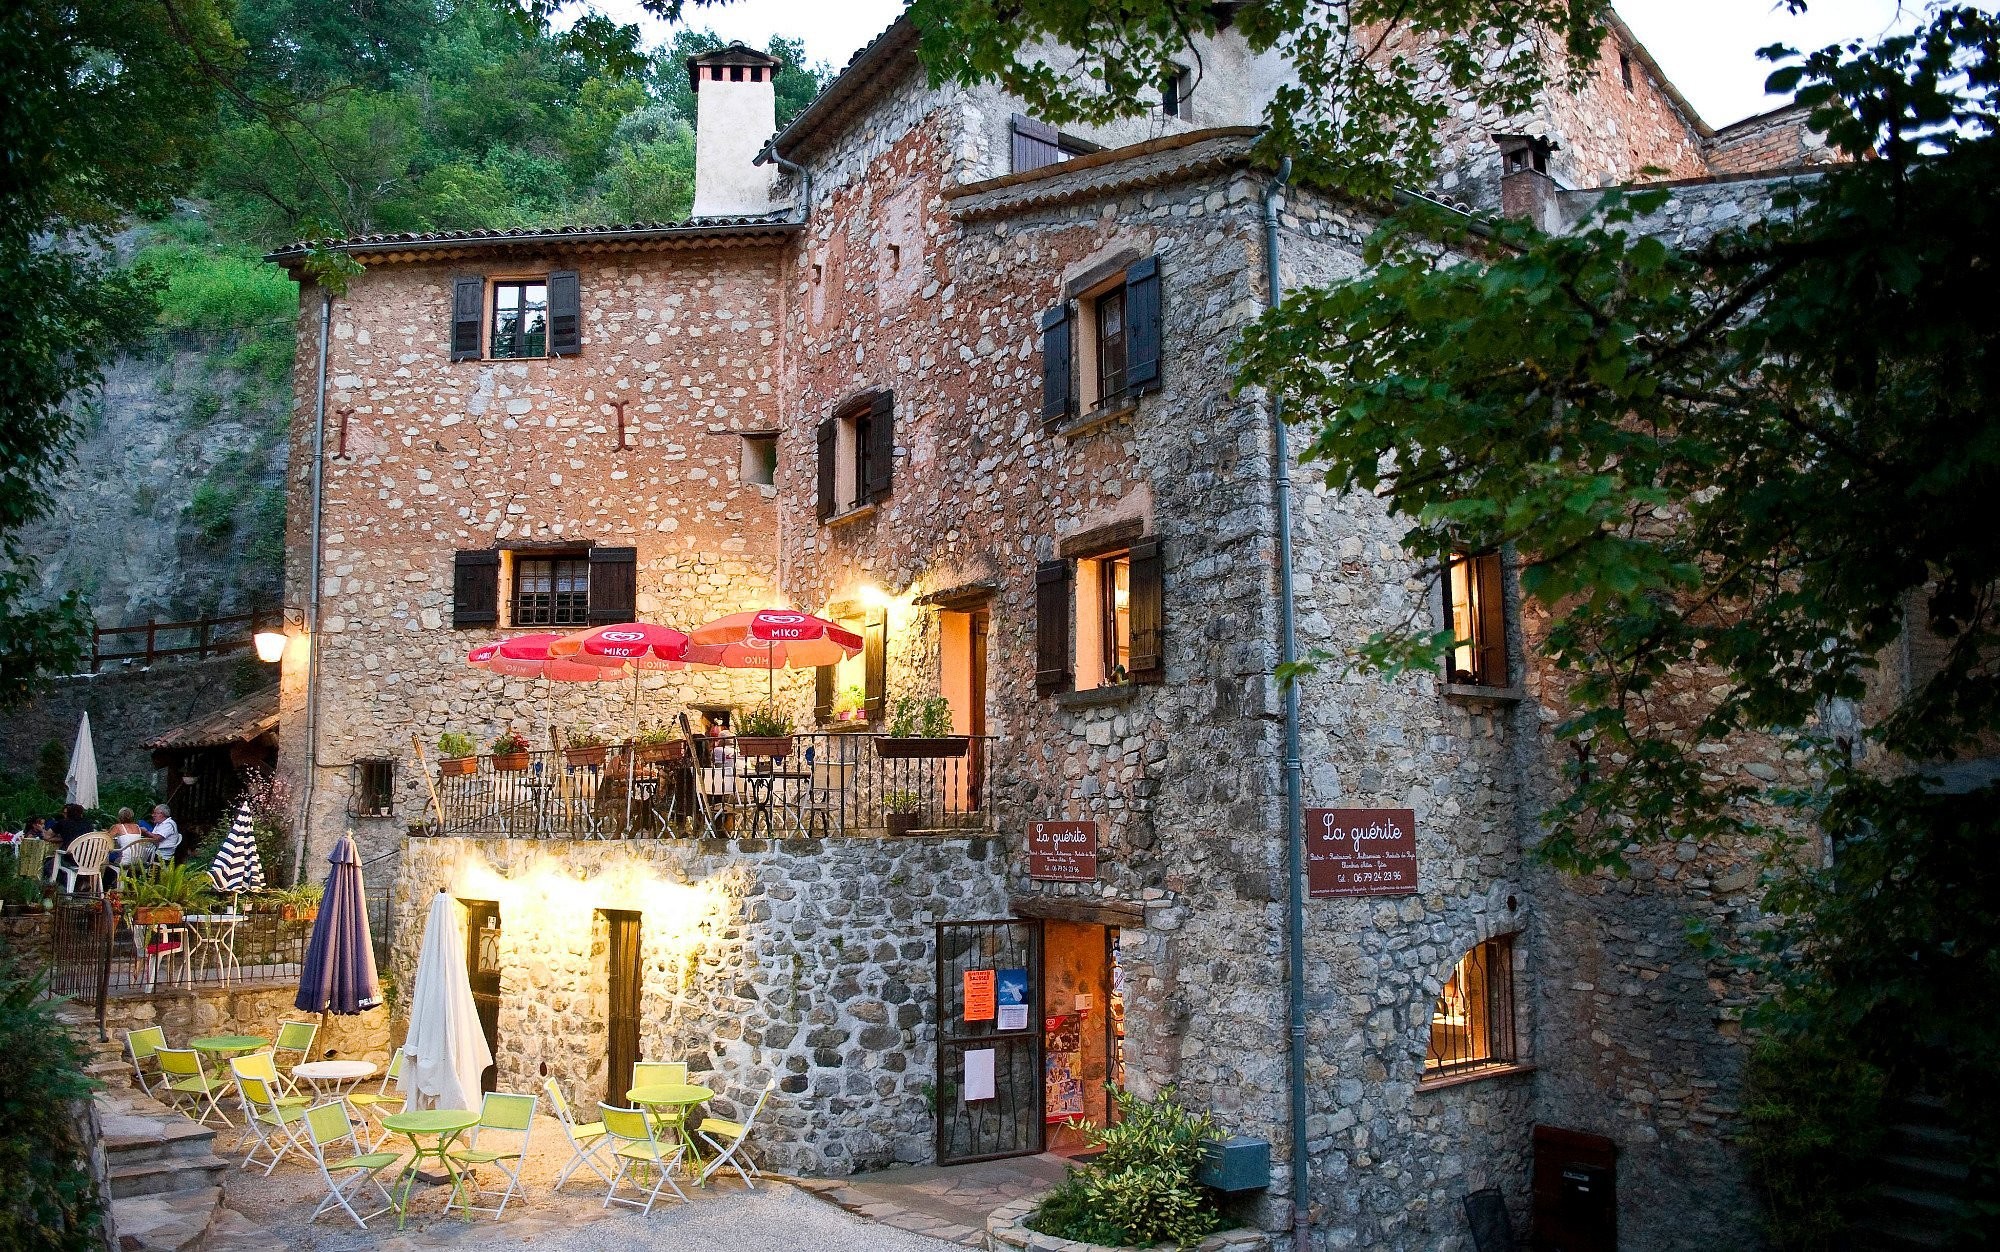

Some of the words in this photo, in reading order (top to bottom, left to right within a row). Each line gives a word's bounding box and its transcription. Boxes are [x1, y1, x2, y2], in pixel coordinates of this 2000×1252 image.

[771, 629, 799, 637] MIKO
[604, 648, 630, 656] MIKO
[1036, 823, 1050, 843] La
[1052, 826, 1087, 851] guérite
[1323, 813, 1345, 840] La
[1351, 818, 1402, 852] guérite
[1353, 873, 1363, 883] 06
[1363, 872, 1373, 882] 79
[1373, 872, 1383, 881] 24
[1383, 871, 1392, 881] 23
[1392, 871, 1402, 881] 96
